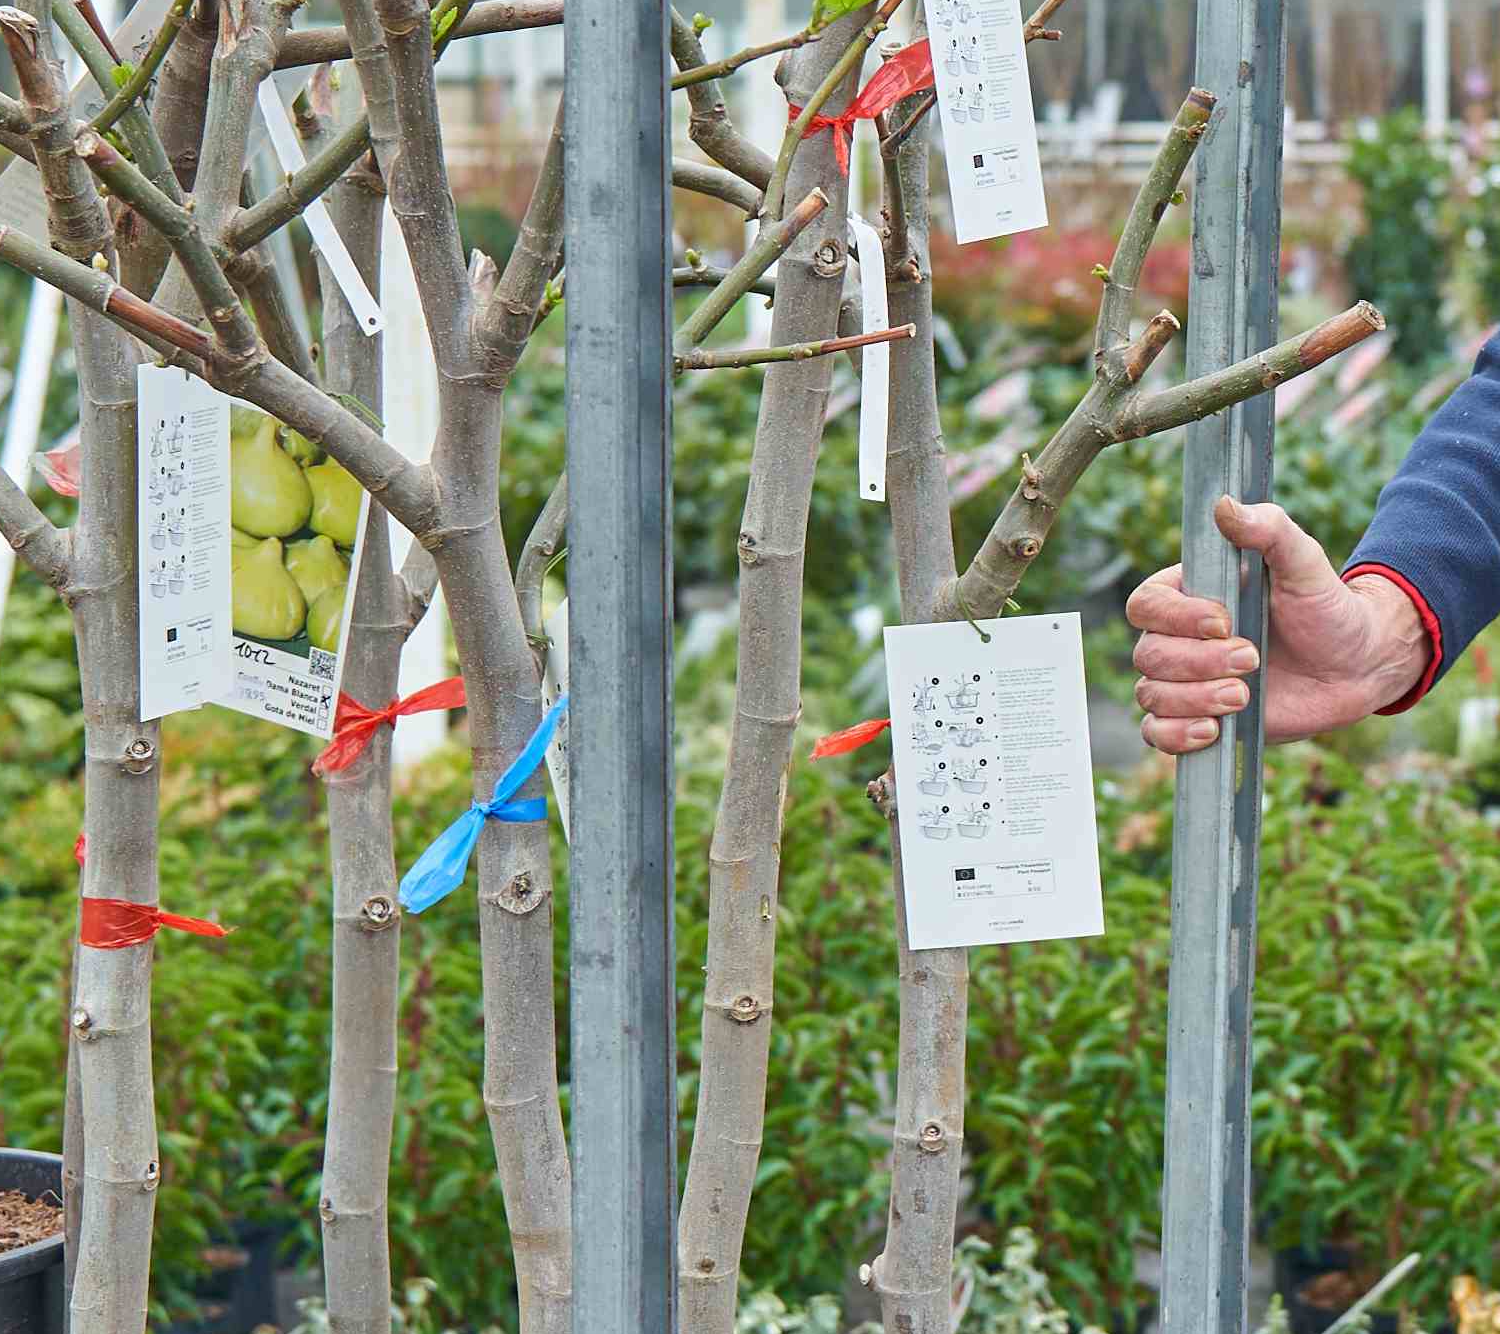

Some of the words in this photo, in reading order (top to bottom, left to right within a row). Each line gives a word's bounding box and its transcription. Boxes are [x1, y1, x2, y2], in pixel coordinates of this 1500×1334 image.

[288, 675, 320, 692] Nazaret
[291, 688, 318, 703] Blanca
[265, 703, 284, 716] Gota
[286, 711, 296, 719] de
[298, 713, 315, 725] Miel
[291, 699, 317, 714] Verdal
